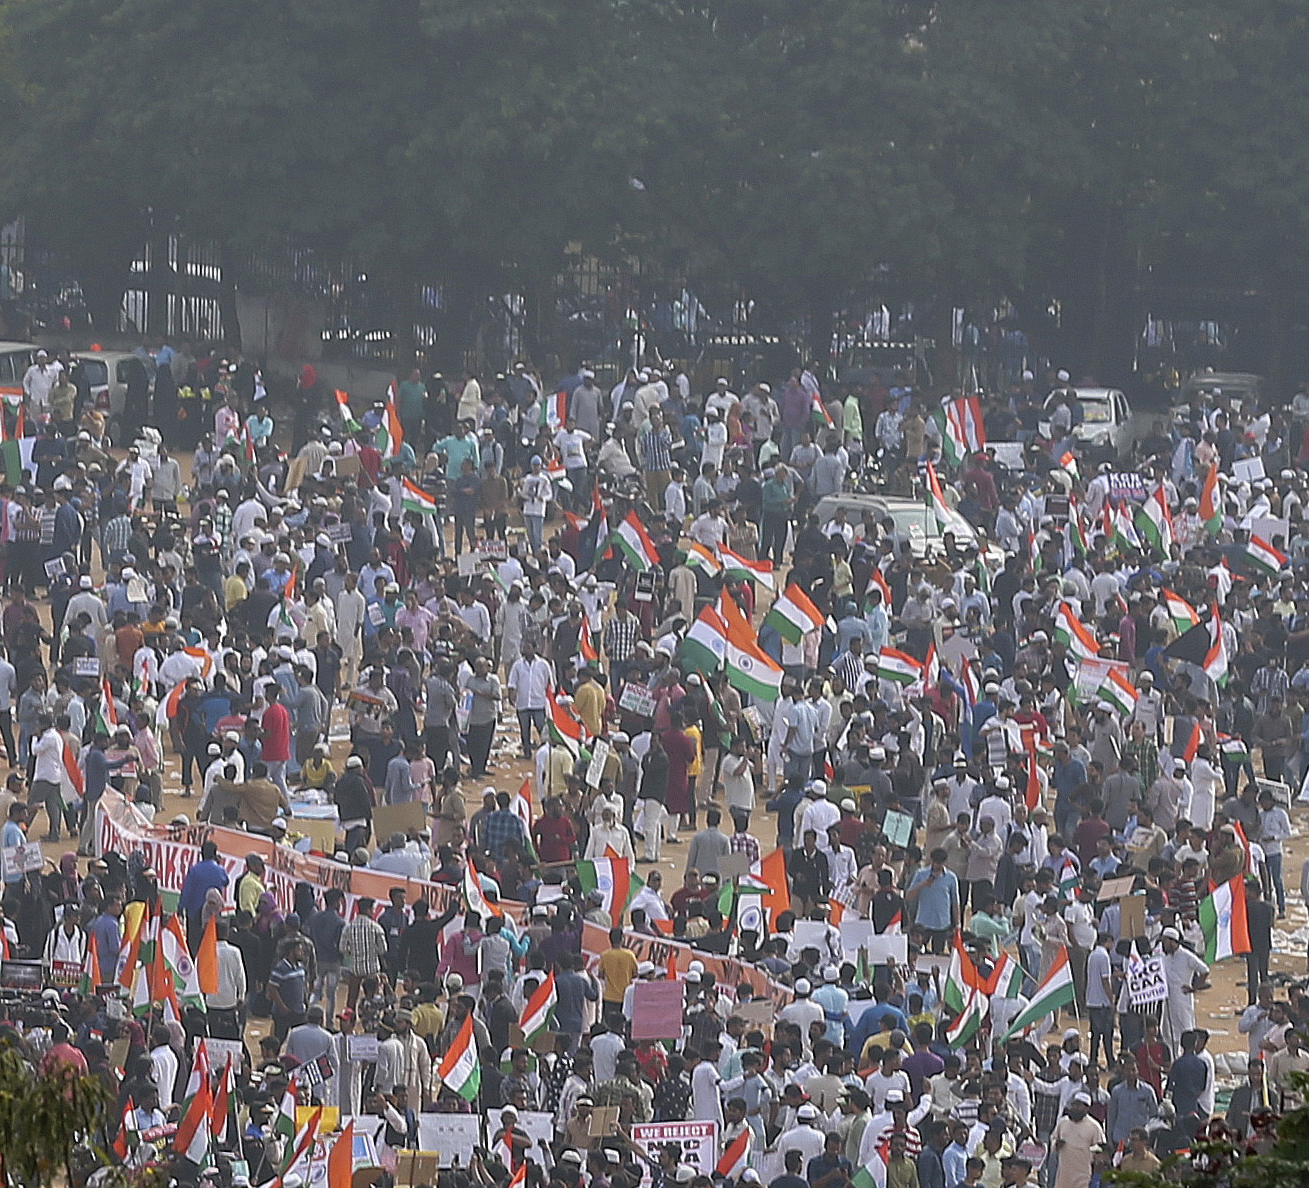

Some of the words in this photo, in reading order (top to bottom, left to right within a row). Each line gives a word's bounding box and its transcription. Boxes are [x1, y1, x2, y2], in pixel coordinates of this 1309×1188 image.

[1130, 973, 1164, 992] CAA
[640, 1127, 660, 1138] WE
[663, 1125, 709, 1137] REJECT
